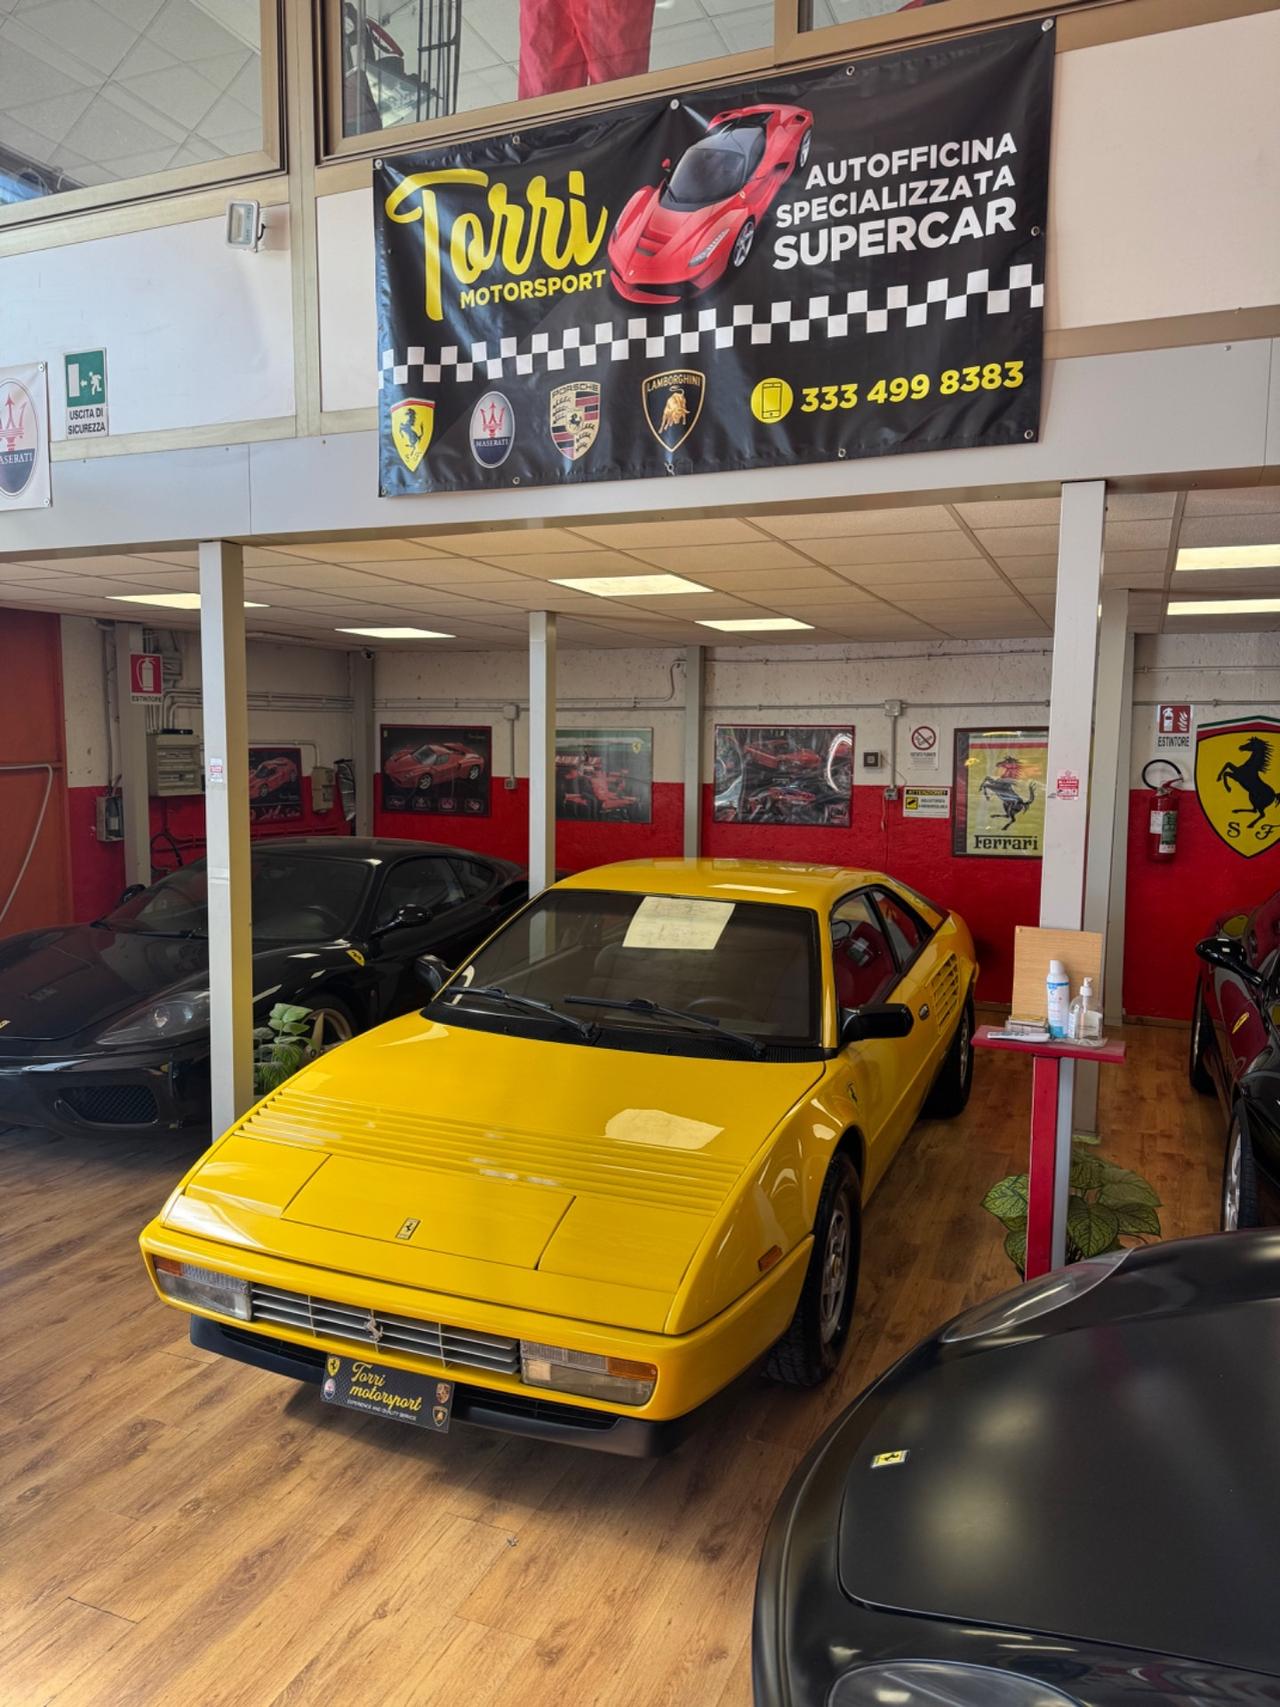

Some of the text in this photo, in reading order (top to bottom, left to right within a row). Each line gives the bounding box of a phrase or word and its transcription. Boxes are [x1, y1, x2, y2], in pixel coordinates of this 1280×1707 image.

[804, 132, 1018, 190] AUTOFFICINA
[776, 165, 1016, 228] SPECIALIZZATA
[772, 197, 1017, 271] SUPERCAR
[385, 168, 608, 321] Torri
[460, 268, 606, 309] MOTORSPORT
[551, 383, 599, 397] PORSCHE
[648, 374, 700, 391] LAMBORGHINI
[800, 360, 1024, 412] 333 499 8383
[69, 408, 103, 420] USCITA DI
[68, 421, 106, 435] SICUREZZA
[476, 439, 509, 447] MASERATI
[0, 452, 33, 464] ASERATI
[1158, 736, 1190, 747] ESTINTORE
[1227, 821, 1241, 838] S
[974, 834, 1038, 850] Ferrari
[351, 1361, 386, 1387] Torri
[349, 1385, 422, 1411] motorsport
